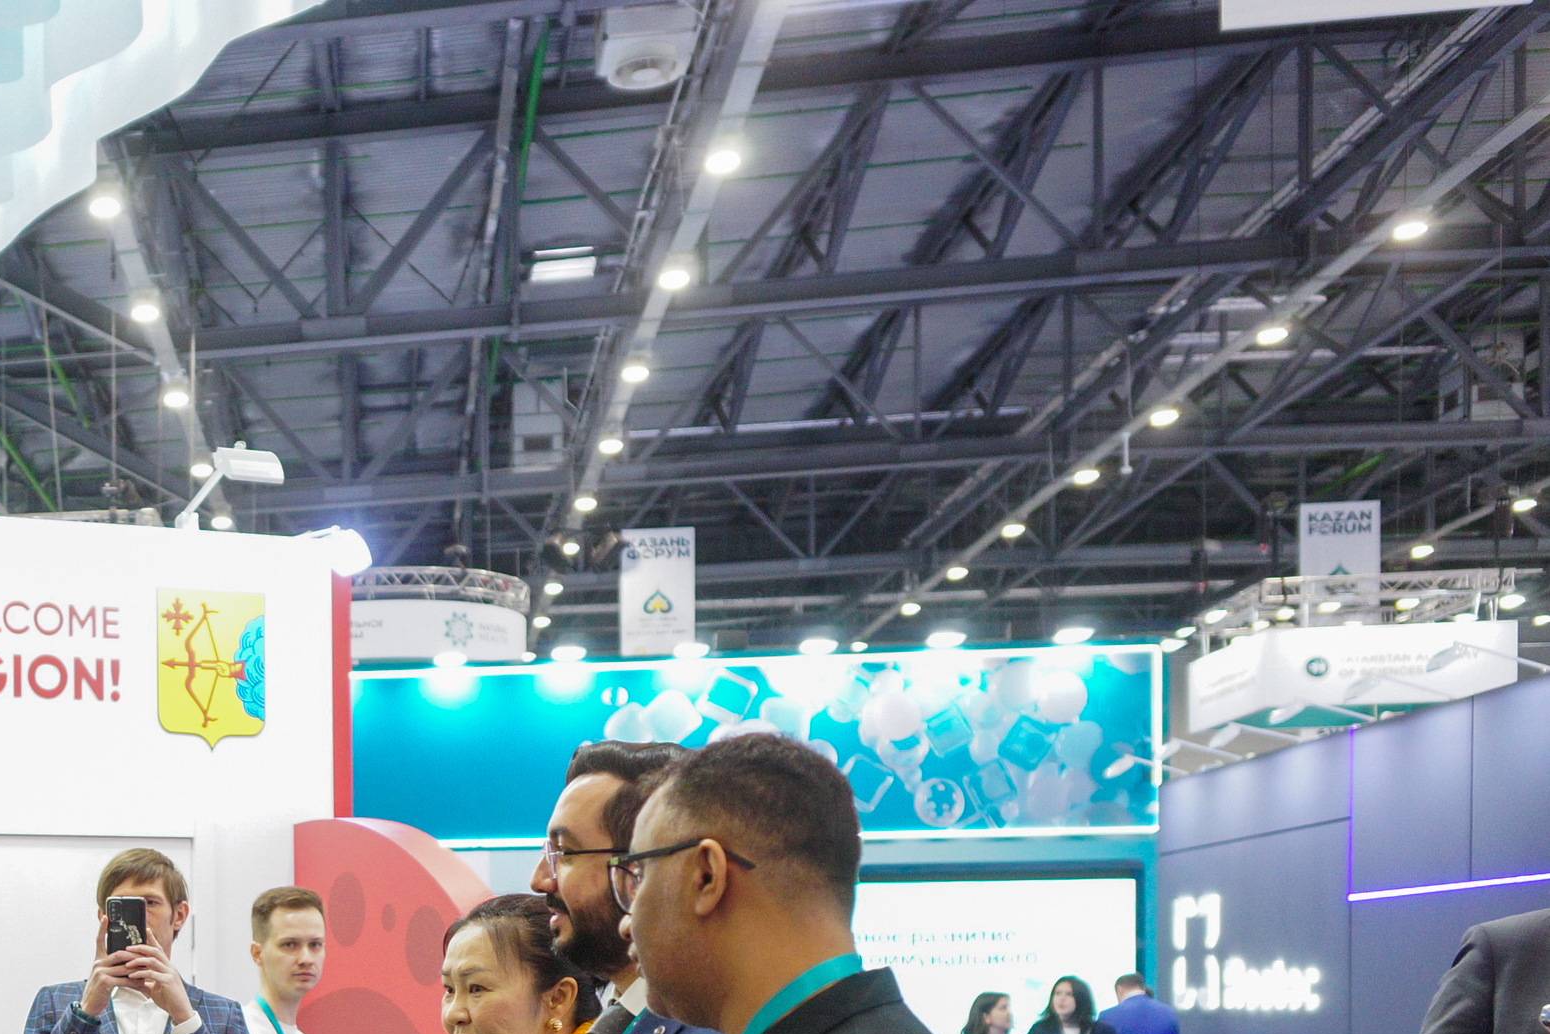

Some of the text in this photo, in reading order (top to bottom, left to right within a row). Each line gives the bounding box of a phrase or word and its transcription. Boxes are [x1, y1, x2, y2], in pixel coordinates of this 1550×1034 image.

[1308, 510, 1372, 522] KAZAN
[1308, 522, 1372, 535] FORUM
[627, 548, 691, 559] ФОРУМ
